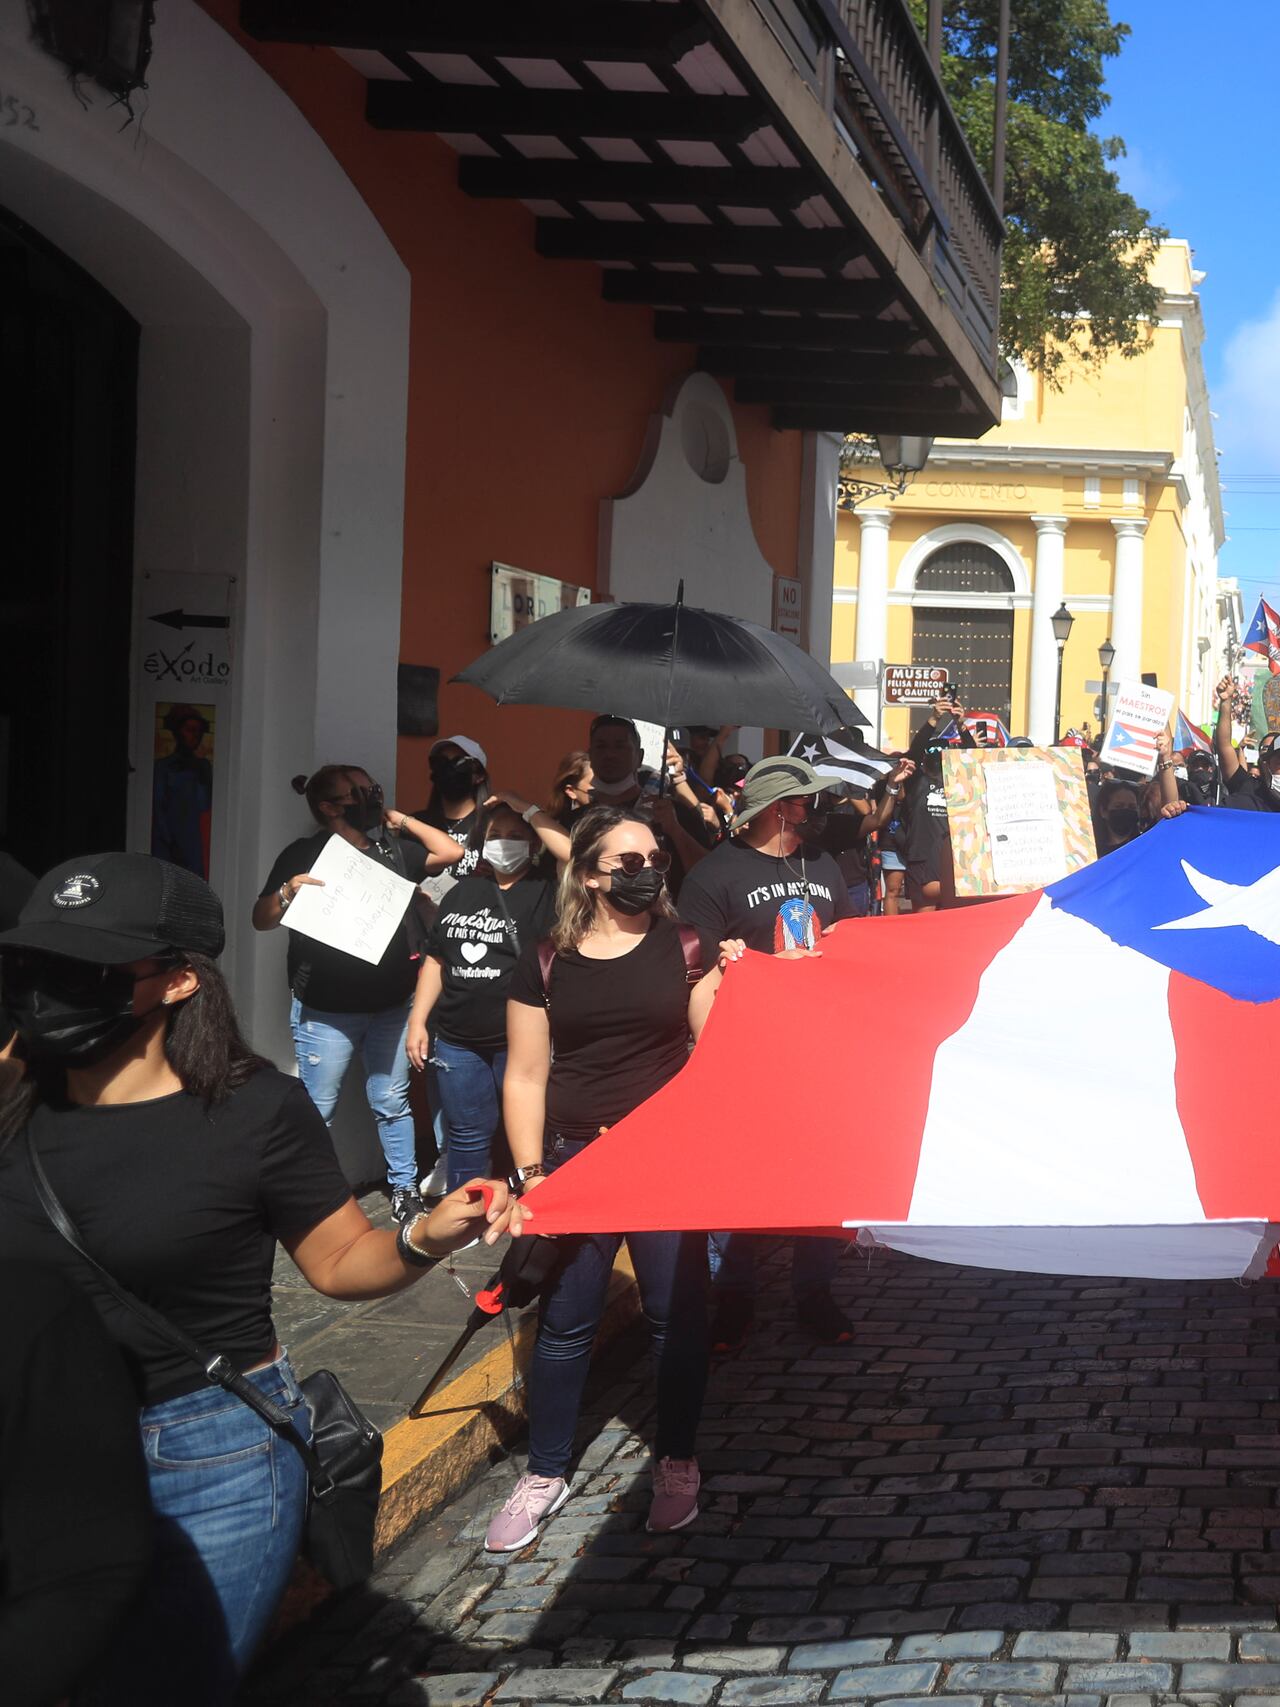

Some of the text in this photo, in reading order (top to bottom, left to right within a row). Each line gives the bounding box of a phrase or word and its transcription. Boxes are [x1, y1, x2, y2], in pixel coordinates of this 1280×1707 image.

[925, 481, 1028, 500] CONVENTO
[783, 586, 797, 604] NO
[892, 669, 941, 680] MUSEO
[887, 680, 912, 688] FELISA
[1119, 696, 1167, 717] MAESTROS
[747, 881, 832, 909] IT'S IN MY DNA
[477, 931, 503, 944] PARALIZA
